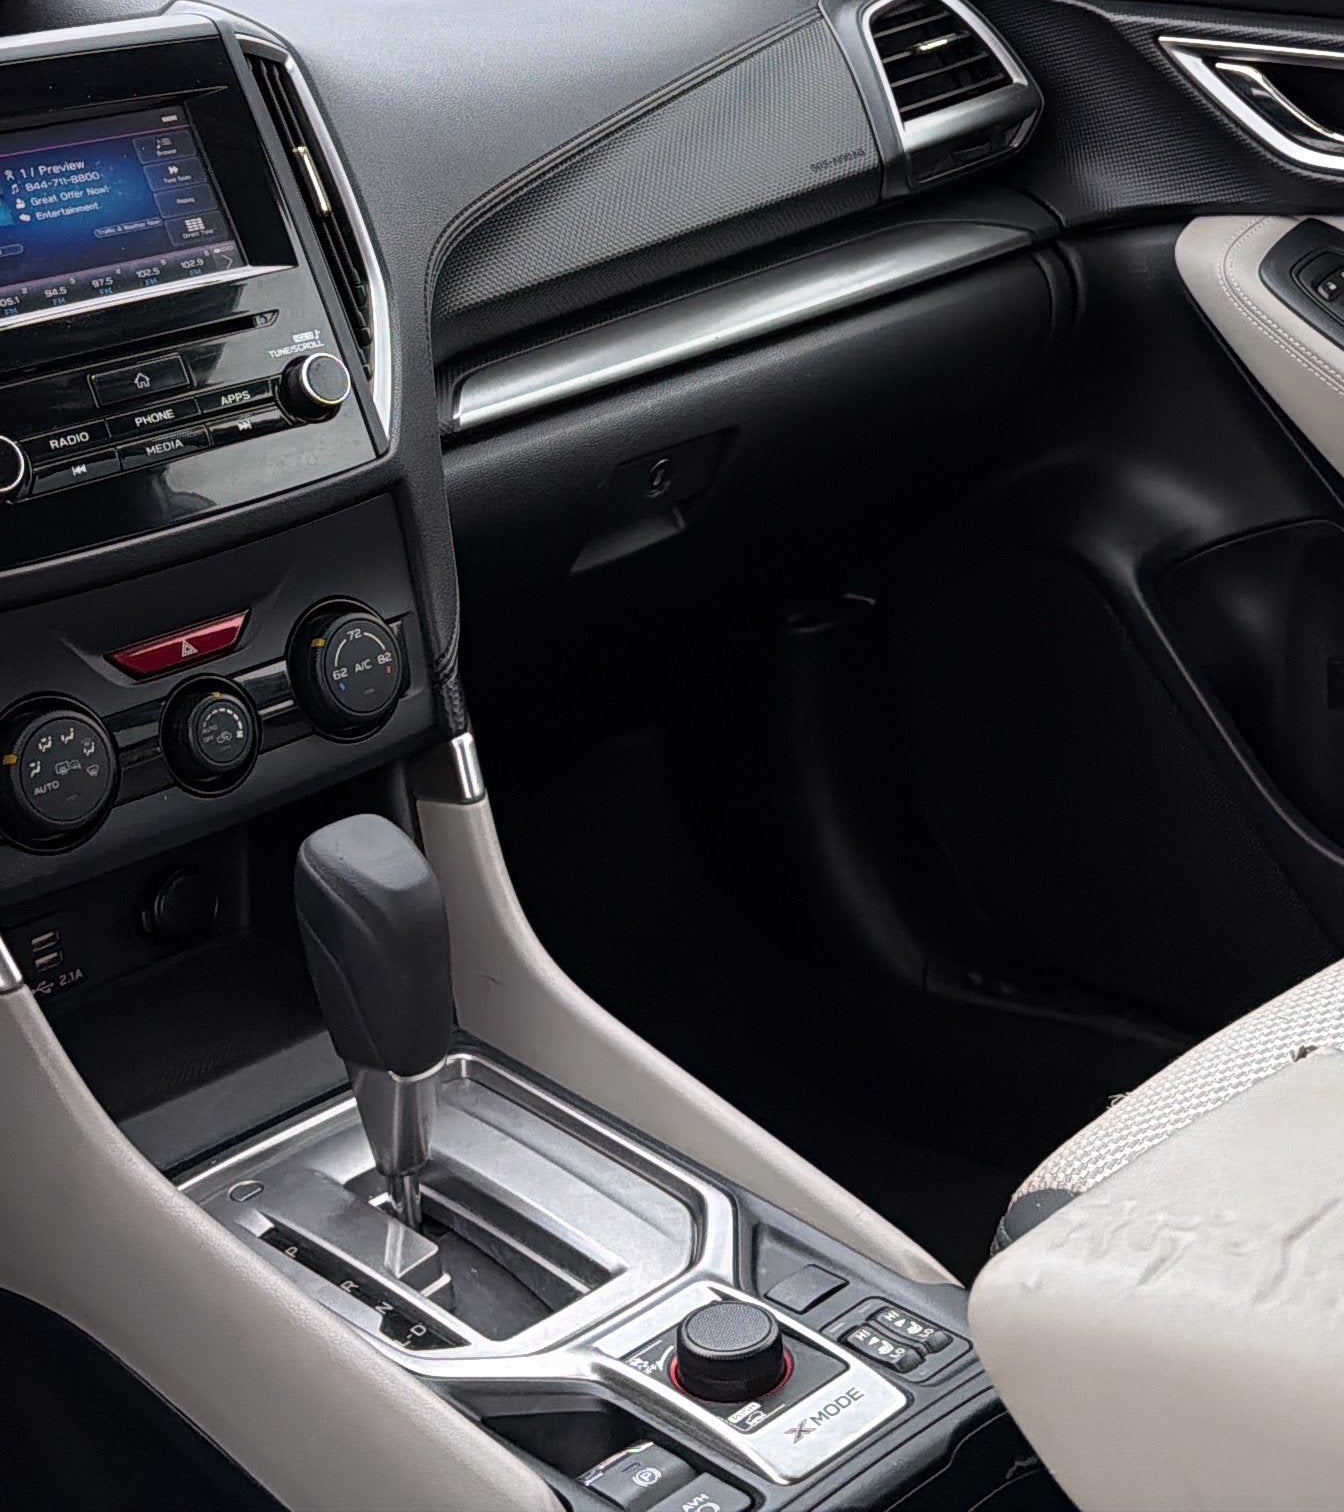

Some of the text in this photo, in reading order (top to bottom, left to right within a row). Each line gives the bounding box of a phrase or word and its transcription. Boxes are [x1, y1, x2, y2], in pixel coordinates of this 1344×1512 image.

[38, 159, 85, 176] Preview
[25, 171, 100, 192] 844-711-8800
[30, 194, 58, 207] Great
[59, 190, 84, 201] Offer
[35, 201, 100, 221] Entertainment
[180, 257, 205, 269] 102.9
[135, 267, 161, 279] 102.5
[91, 276, 114, 289] 97.5
[268, 340, 325, 358] TUNE/SCROLL
[219, 390, 251, 406] APPS
[134, 408, 176, 428] PHONE
[49, 431, 90, 450] RADIO
[145, 438, 184, 456] MEDIA
[346, 628, 362, 640] 72
[354, 658, 373, 673] A/C
[377, 651, 393, 665] 82
[332, 667, 348, 680] 62
[34, 780, 60, 796] AUTO
[59, 968, 84, 986] 2.1A
[284, 1246, 299, 1258] P
[339, 1280, 360, 1293] R
[374, 1300, 394, 1314] N
[811, 1387, 865, 1427] MODE
[682, 1493, 710, 1512] AVH
